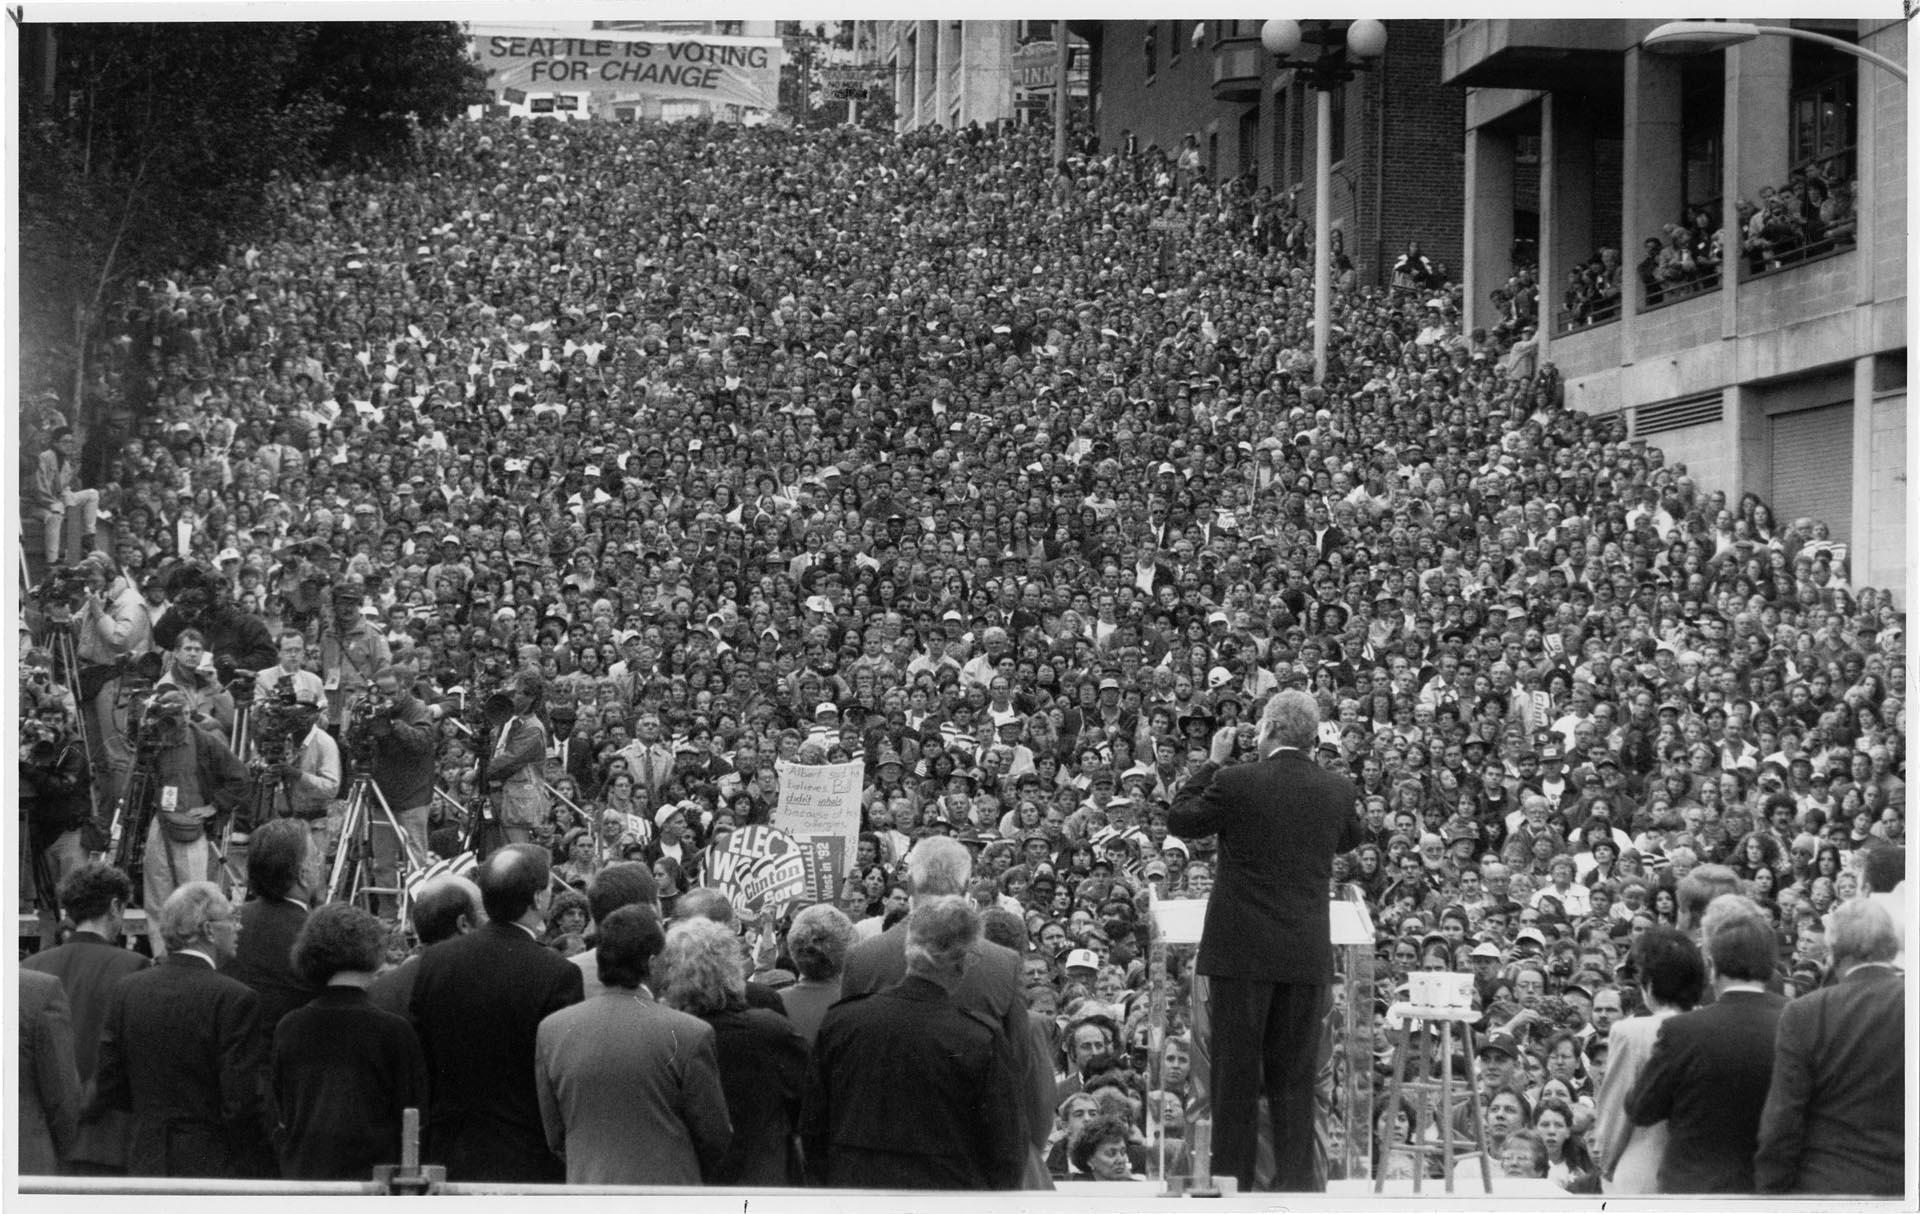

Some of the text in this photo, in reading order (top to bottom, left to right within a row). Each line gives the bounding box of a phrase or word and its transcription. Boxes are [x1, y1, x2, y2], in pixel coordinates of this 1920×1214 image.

[489, 36, 769, 69] SEATTLE IS VOTING
[531, 60, 723, 90] FOR CHANGE
[728, 826, 801, 858] ELECT
[744, 865, 800, 900] Clinton
[817, 842, 834, 900] West in '92
